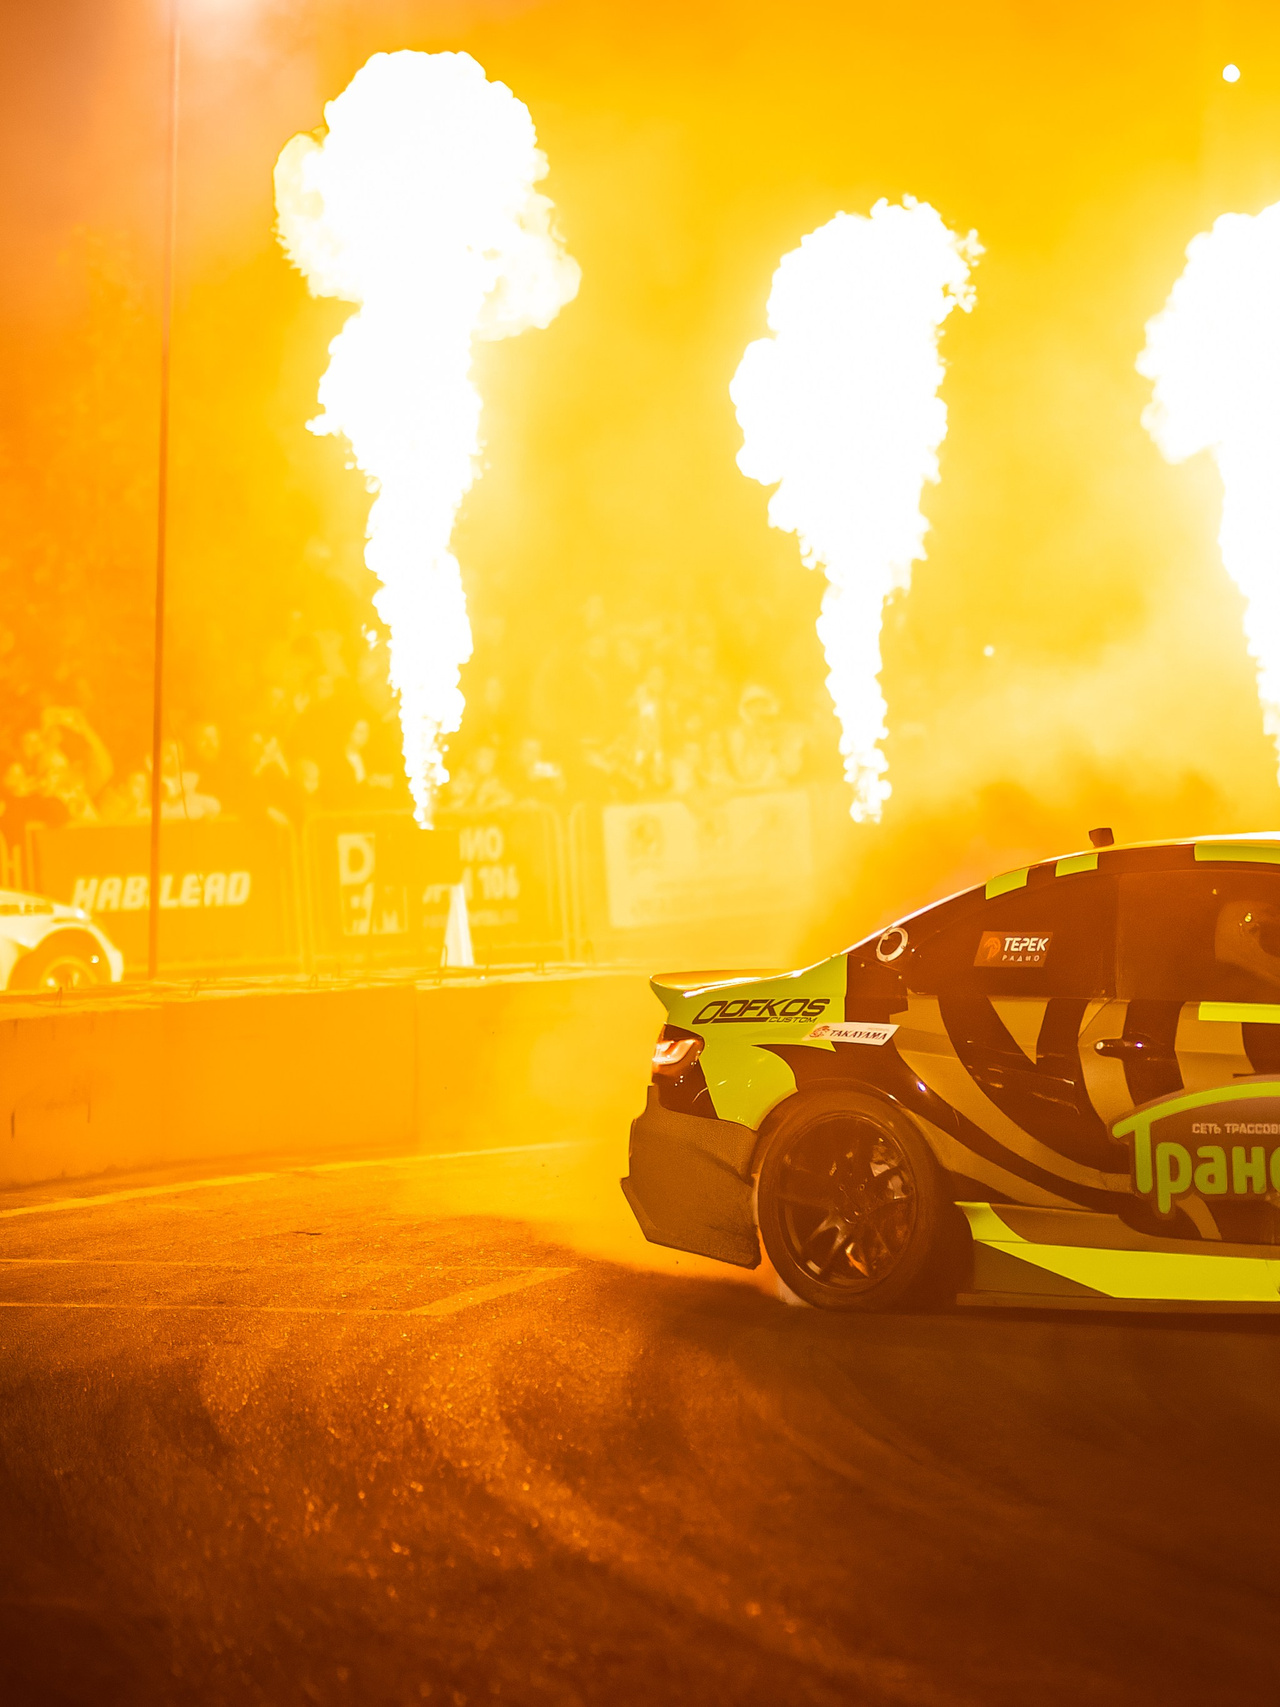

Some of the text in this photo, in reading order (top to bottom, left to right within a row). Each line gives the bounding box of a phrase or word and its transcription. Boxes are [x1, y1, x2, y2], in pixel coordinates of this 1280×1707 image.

[71, 870, 251, 912] HABLEAD
[1003, 937, 1049, 952] ТЕРЕК
[1002, 954, 1040, 962] РАДИО
[768, 1016, 818, 1024] CUSTOM
[829, 1029, 888, 1041] TAKAYAMA
[1191, 1123, 1222, 1134] СЕТЬ
